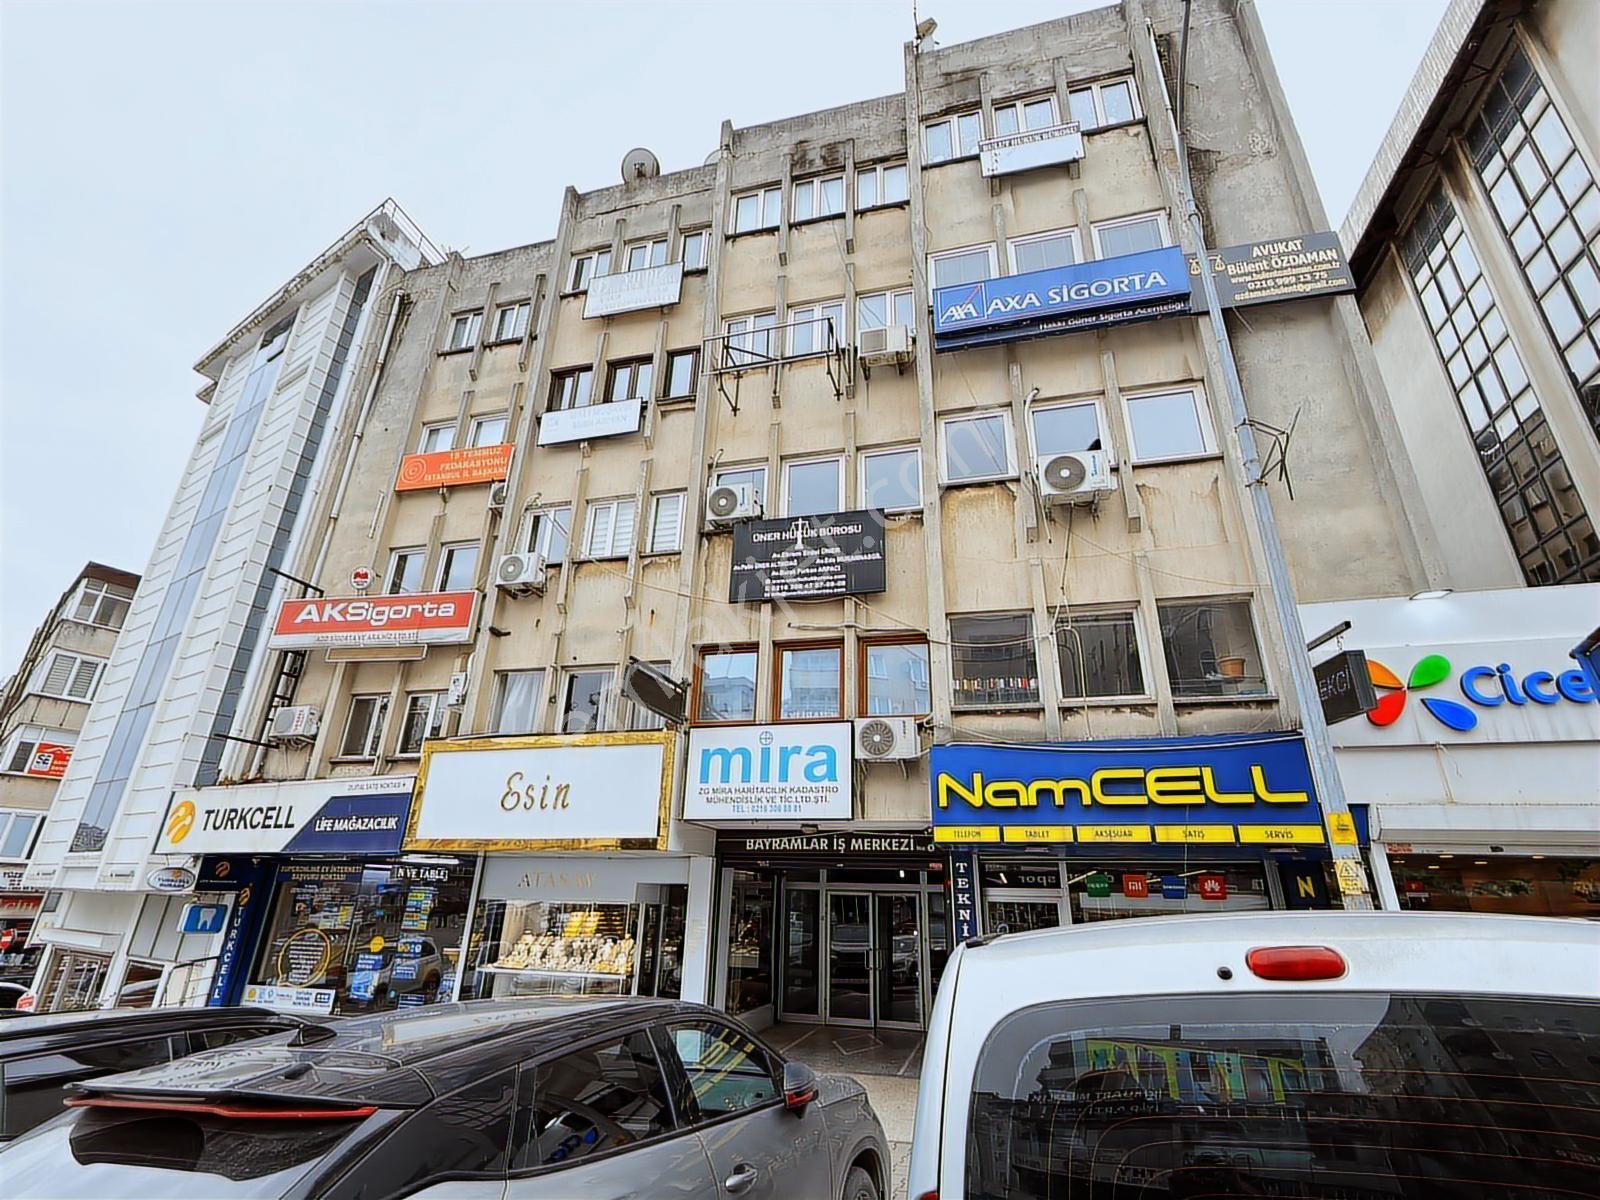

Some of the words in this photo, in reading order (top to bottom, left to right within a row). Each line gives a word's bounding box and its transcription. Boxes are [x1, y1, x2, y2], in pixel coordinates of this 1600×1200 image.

[1253, 240, 1302, 258] AVUKAT
[1227, 259, 1269, 275] Bülent
[1271, 249, 1338, 268] ÖZDAMAN
[986, 292, 1041, 315] AXA
[1048, 271, 1167, 304] SİGORTA
[941, 303, 978, 322] AXA
[294, 602, 455, 626] AKSigorta
[699, 731, 838, 784] mira
[500, 771, 571, 811] Esin
[712, 787, 732, 795] MİRA
[937, 765, 1309, 808] NamCELL
[202, 805, 295, 831] TURKCELL
[315, 817, 334, 831] LİFE
[334, 815, 400, 830] MAĞAZACILIK
[746, 838, 828, 850] BAYRAMLAR
[833, 835, 845, 853] İŞ
[851, 834, 914, 851] MERKEZİ
[1024, 830, 1049, 839] TABLET
[1183, 830, 1205, 839] SATIŞ
[1264, 829, 1293, 839] SERVİS
[1298, 877, 1315, 898] N
[214, 906, 244, 998] TURKCELL
